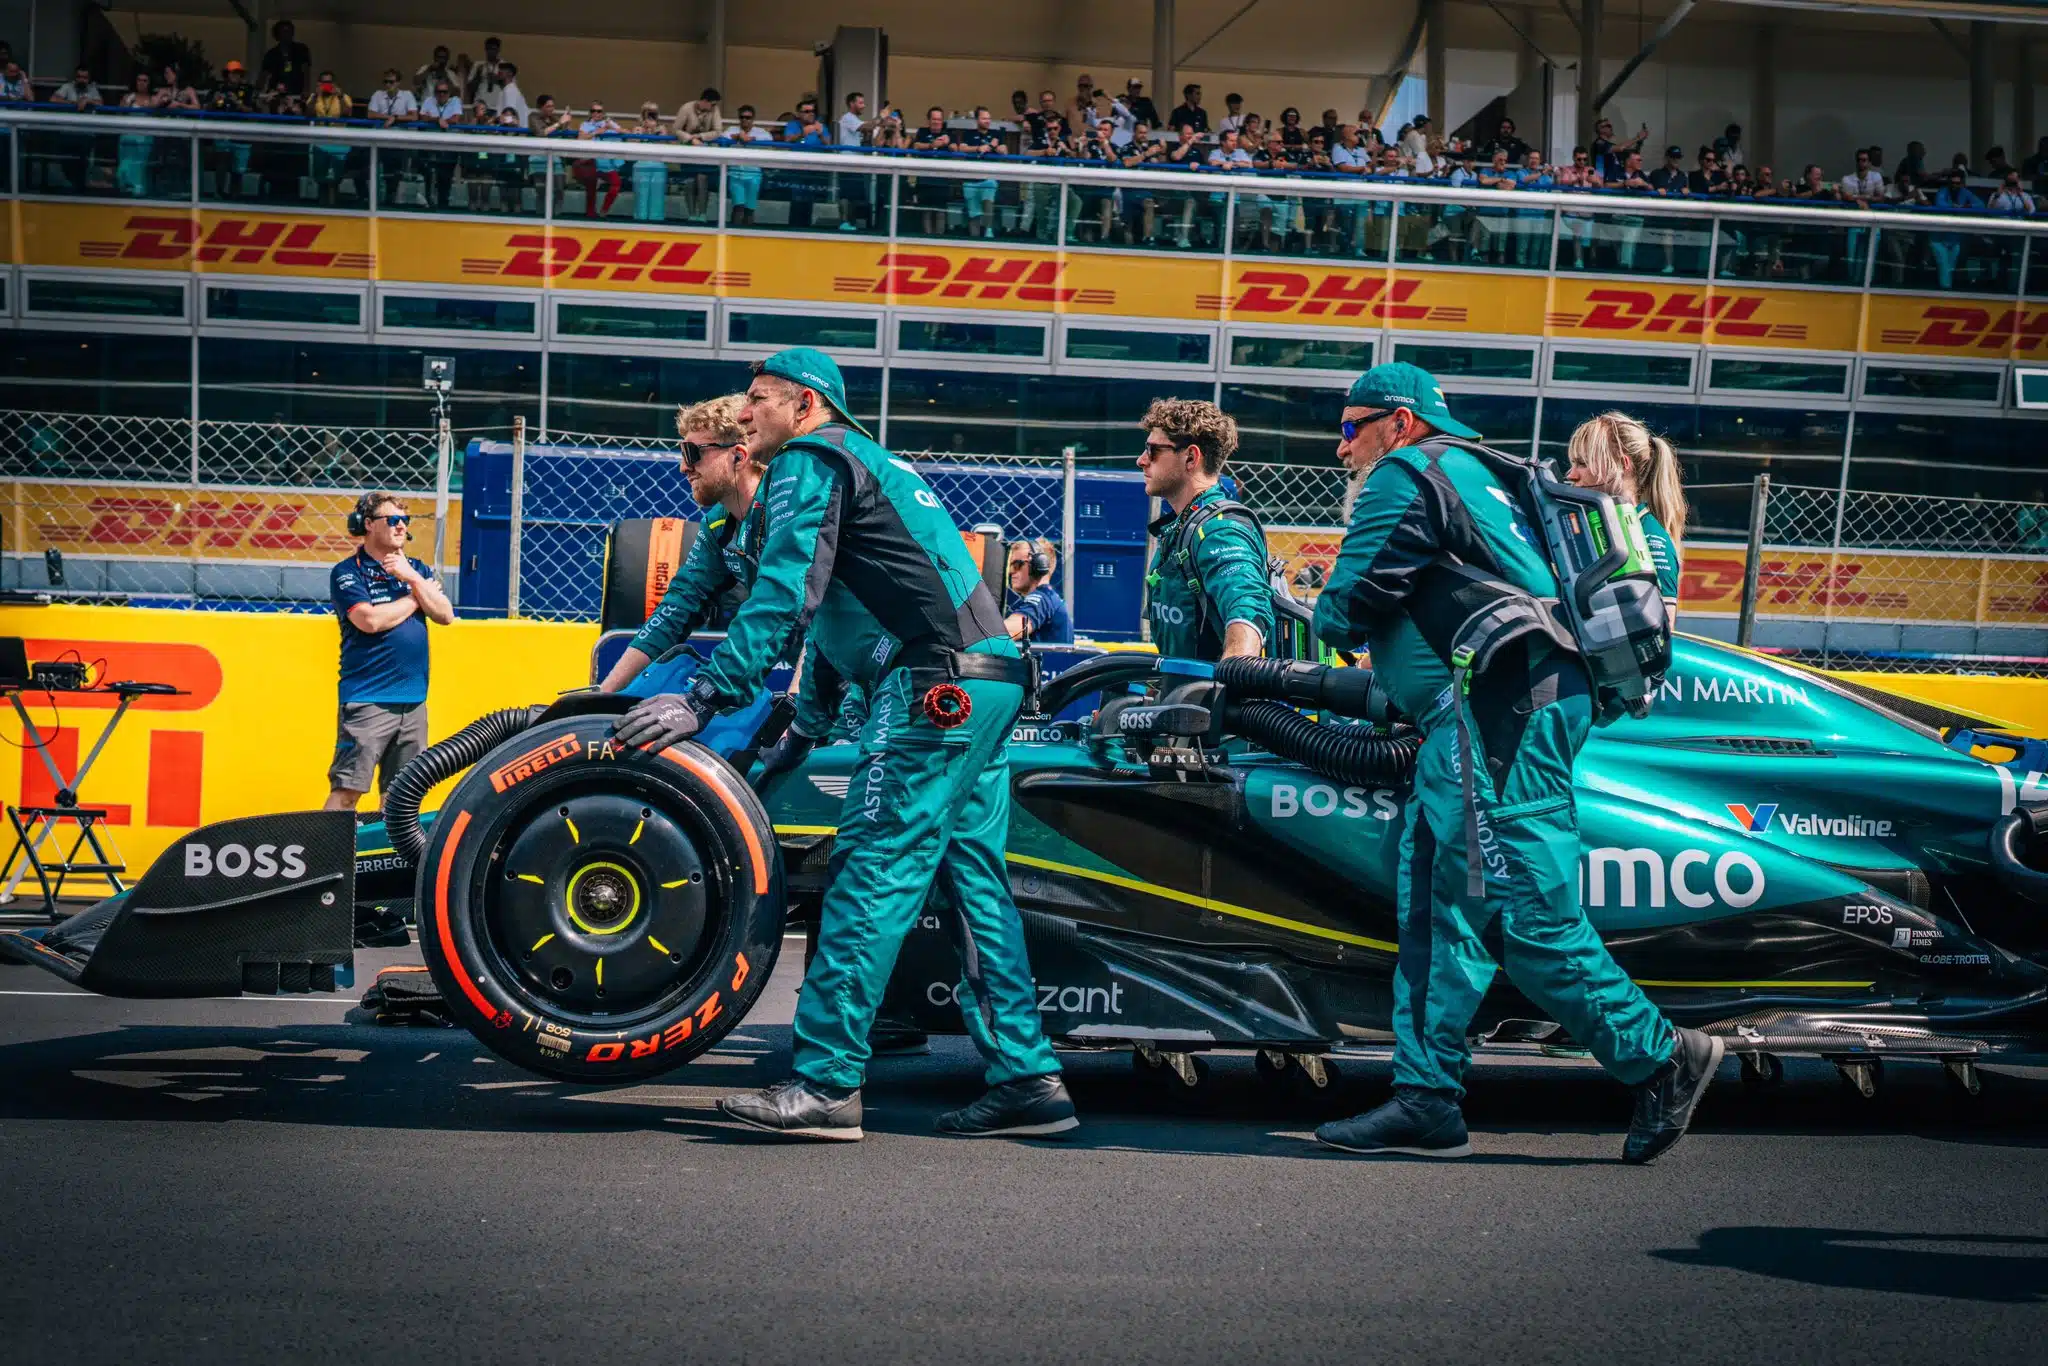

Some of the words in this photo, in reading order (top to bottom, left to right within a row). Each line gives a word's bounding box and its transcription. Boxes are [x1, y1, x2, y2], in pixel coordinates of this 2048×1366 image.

[121, 216, 339, 268] DHL
[501, 234, 713, 285] DHL
[872, 253, 1078, 302] DHL
[1232, 271, 1431, 319] DHL
[1580, 288, 1772, 337] DHL
[1917, 306, 2048, 350] DH
[801, 371, 829, 388] aramco
[1384, 394, 1416, 404] aramco
[85, 496, 319, 549] DHL
[1677, 559, 1869, 607] DHL
[874, 637, 892, 664] OMP
[1693, 676, 1809, 706] MARTIN
[1120, 711, 1154, 730] BOSS
[489, 733, 581, 794] PIRELLI
[587, 741, 615, 760] FA
[1151, 754, 1221, 764] OAKLEY
[863, 751, 886, 823] ASTON
[1271, 784, 1399, 821] BOSS
[1779, 813, 1893, 837] Valvoline
[185, 843, 307, 879] BOSS
[1579, 847, 1765, 908] mco
[1843, 905, 1893, 925] EPOS
[1911, 930, 1945, 939] FINANCIAL
[1911, 938, 1933, 946] TIMES
[731, 952, 749, 992] P
[1919, 954, 1991, 965] GLOBE-TROTTER
[585, 991, 724, 1063] ZERO
